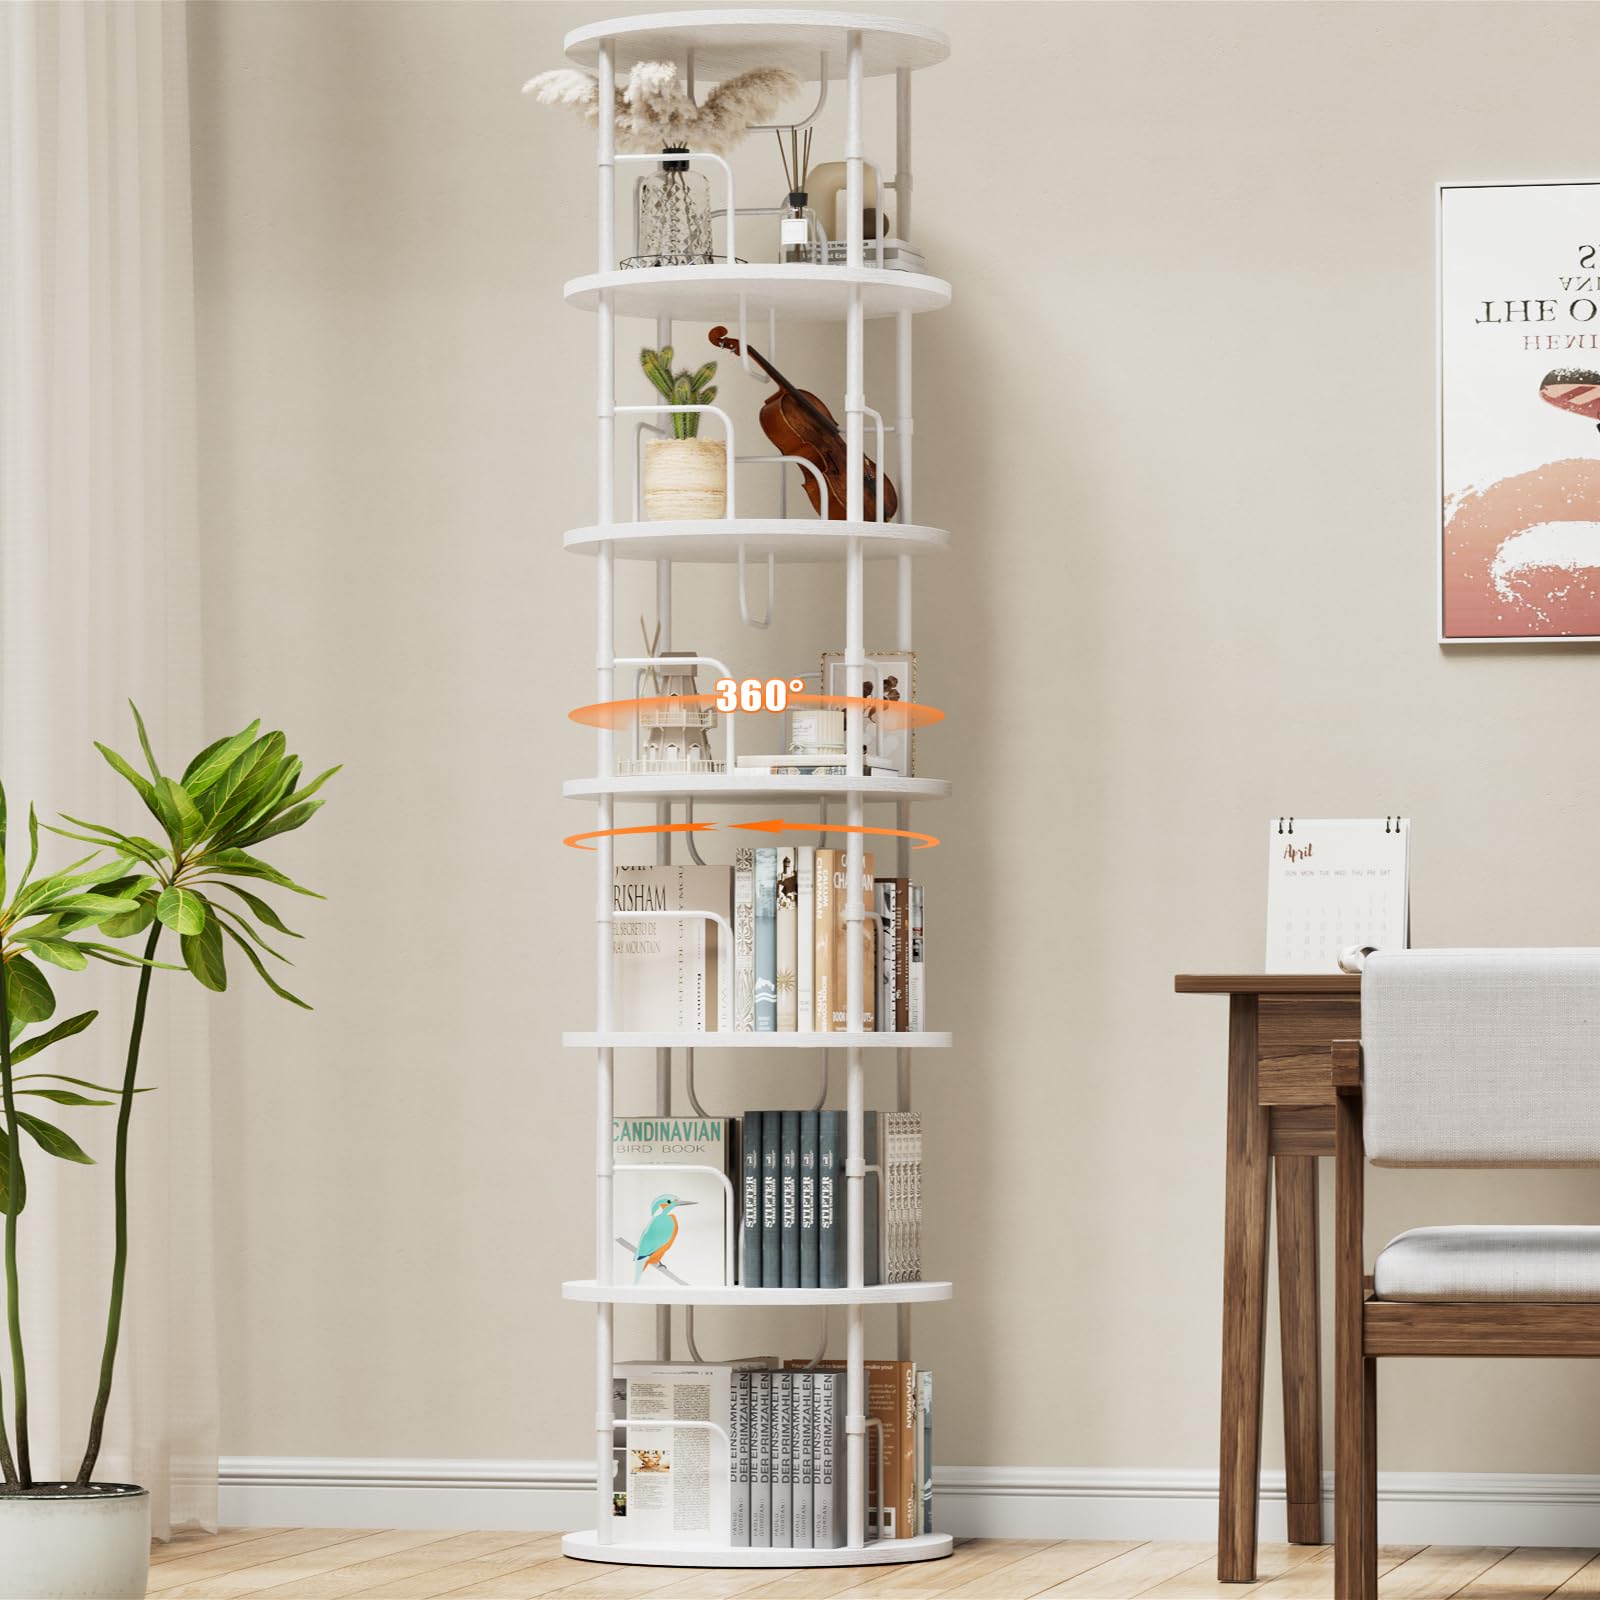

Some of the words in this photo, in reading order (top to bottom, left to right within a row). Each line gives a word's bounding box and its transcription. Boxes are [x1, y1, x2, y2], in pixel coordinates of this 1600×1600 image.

[1283, 843, 1312, 863] April
[833, 871, 874, 892] CHAAN
[613, 884, 666, 911] RISHAM
[613, 1120, 721, 1142] CANDINAVIAN
[616, 1144, 653, 1153] BIRD
[662, 1144, 705, 1153] BOOK
[746, 1176, 754, 1228] STIFTER
[764, 1176, 772, 1228] STIFTER
[802, 1176, 810, 1228] STIFTER
[821, 1176, 829, 1228] STIFTER
[740, 1373, 748, 1453] PRIMZAHLEN
[761, 1374, 769, 1454] PRIMZAHLEN
[782, 1374, 790, 1454] PRIMZAHLEN
[803, 1375, 811, 1454] PRIMZAHLEN
[824, 1375, 832, 1455] PRIMZAHLEN
[740, 1458, 748, 1483] DER
[761, 1458, 769, 1483] DER
[782, 1459, 790, 1483] DER
[803, 1459, 811, 1484] DER
[824, 1460, 832, 1484] DER
